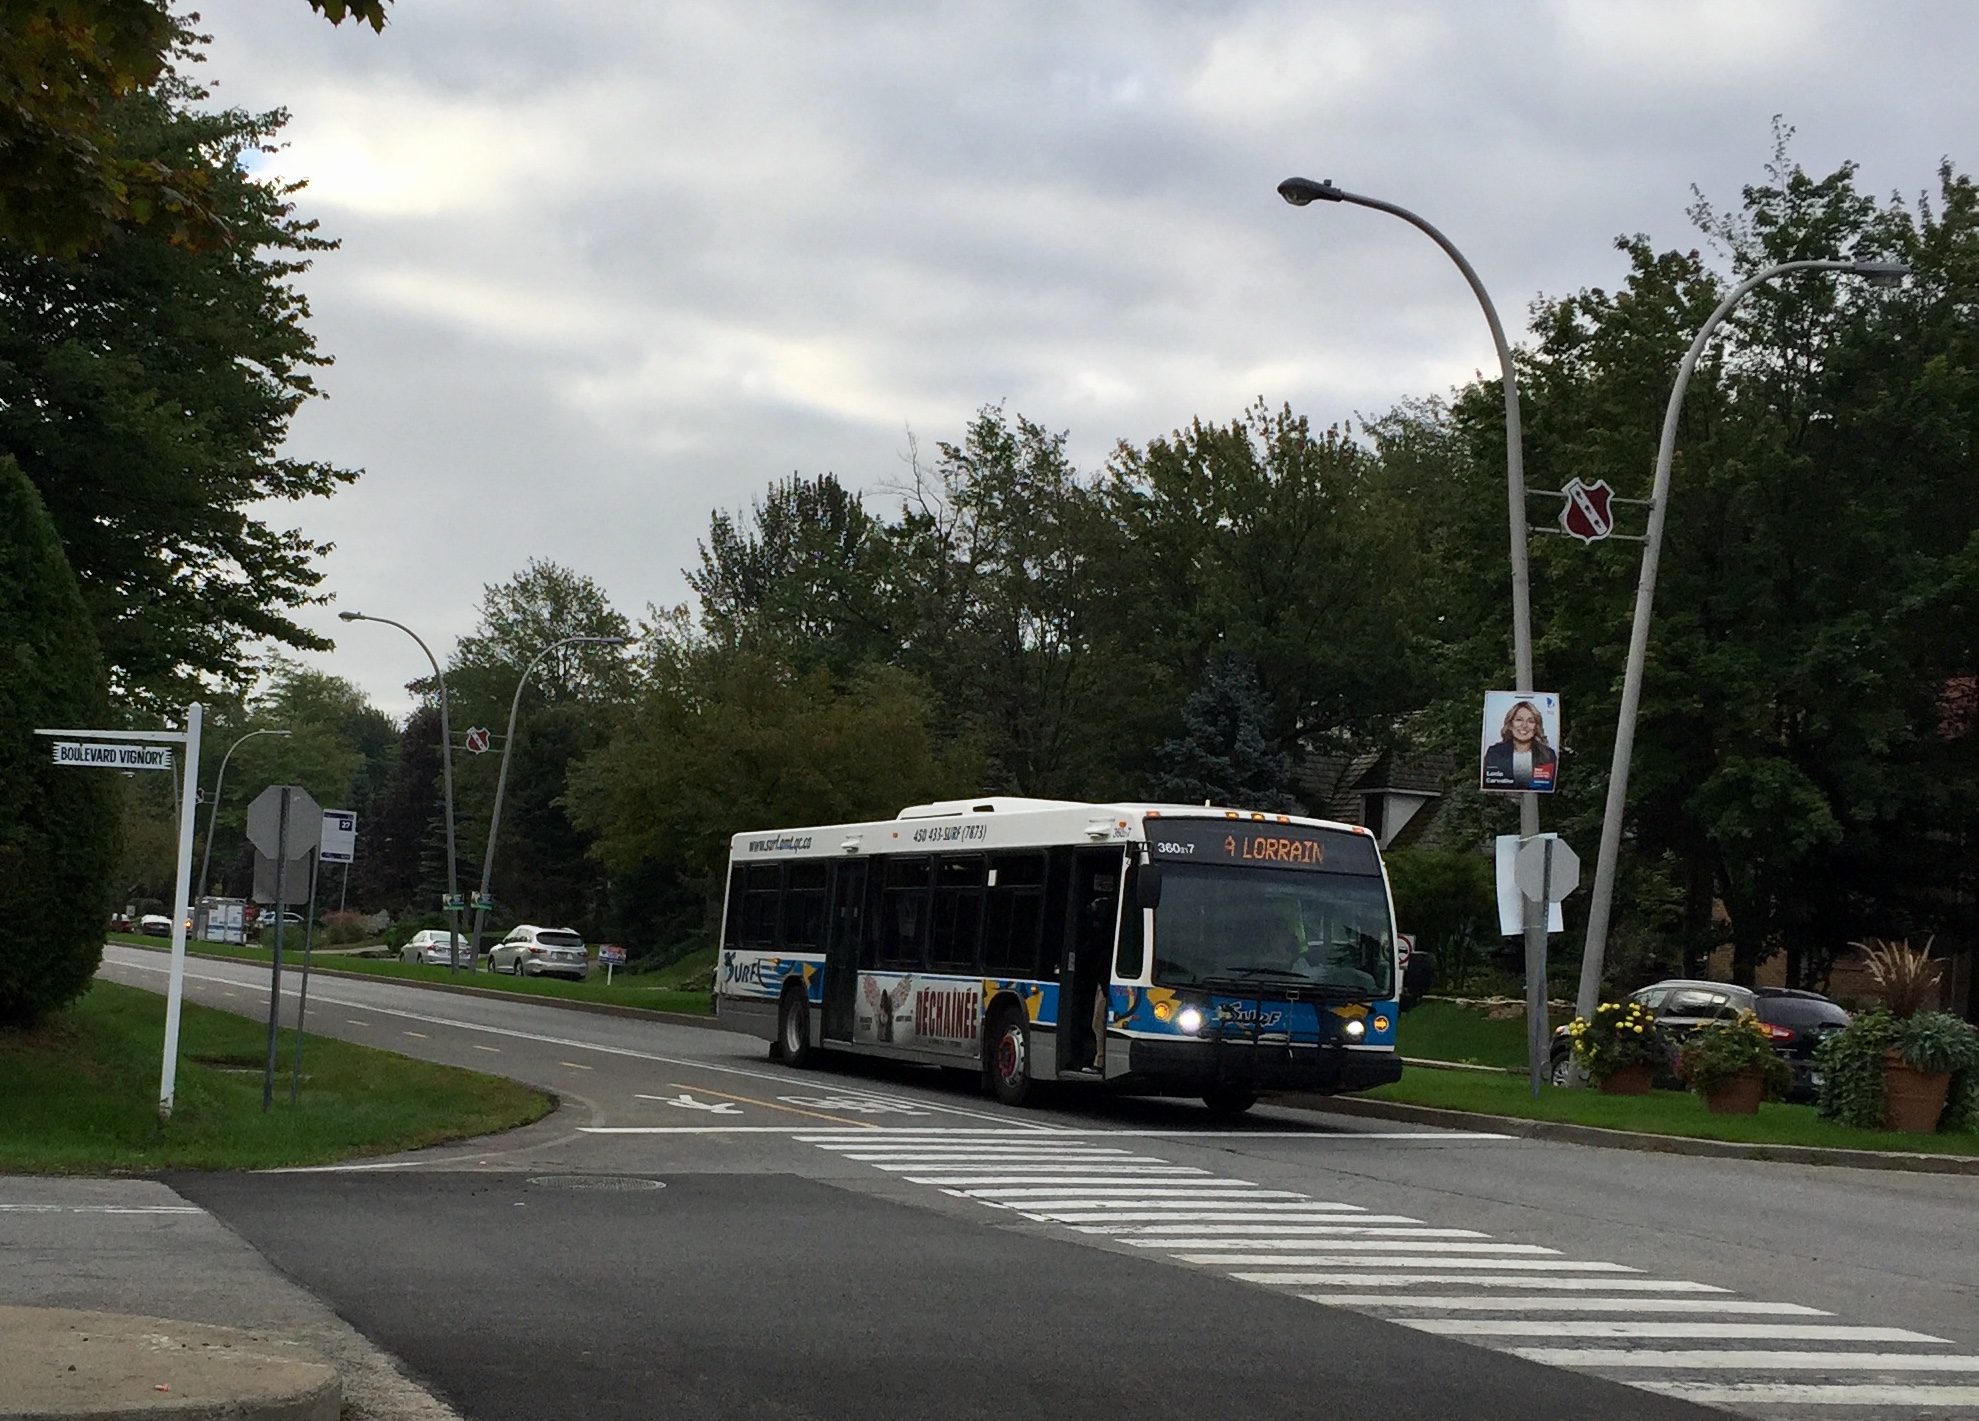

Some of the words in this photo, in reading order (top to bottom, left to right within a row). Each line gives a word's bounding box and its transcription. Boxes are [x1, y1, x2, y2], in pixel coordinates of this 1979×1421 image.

[61, 746, 117, 763] BOULEVARD
[119, 749, 165, 766] VIGNORY
[913, 828, 928, 843] 450
[961, 824, 987, 843] (7873)
[915, 986, 979, 1040] DÉCHAÎNÉE
